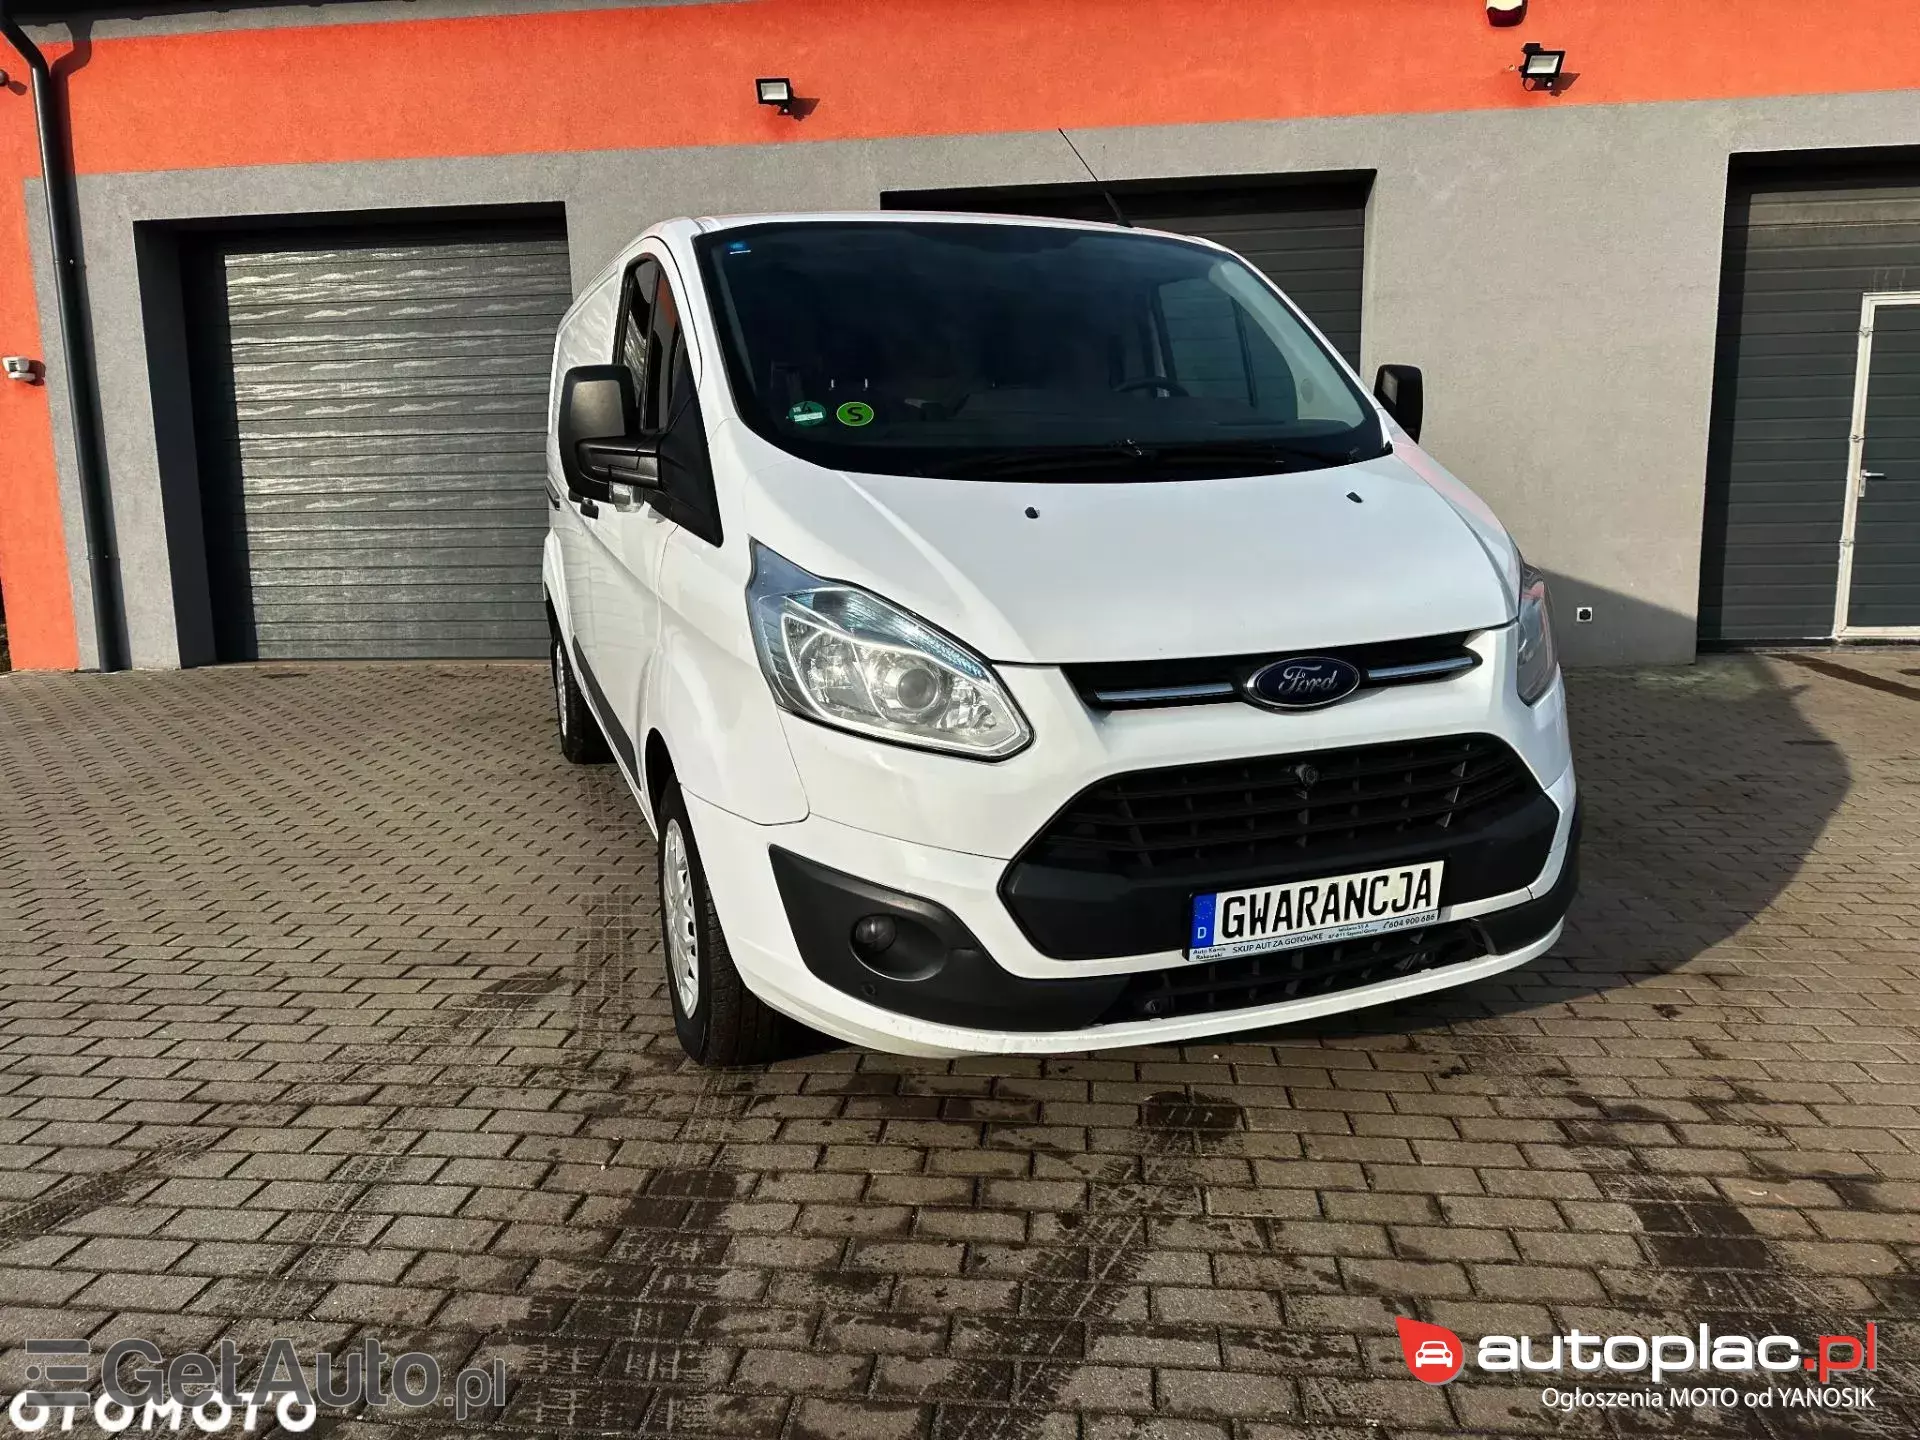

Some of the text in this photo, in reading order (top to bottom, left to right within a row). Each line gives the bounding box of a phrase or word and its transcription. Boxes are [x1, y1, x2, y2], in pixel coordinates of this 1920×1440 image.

[847, 406, 863, 422] S
[1278, 665, 1338, 694] Ford
[1221, 868, 1432, 939] GWARANCJA
[1389, 920, 1403, 928] 604
[1197, 927, 1206, 939] D
[1233, 944, 1255, 954] SKUP
[1255, 941, 1271, 950] AUT
[1273, 940, 1284, 948] ZA
